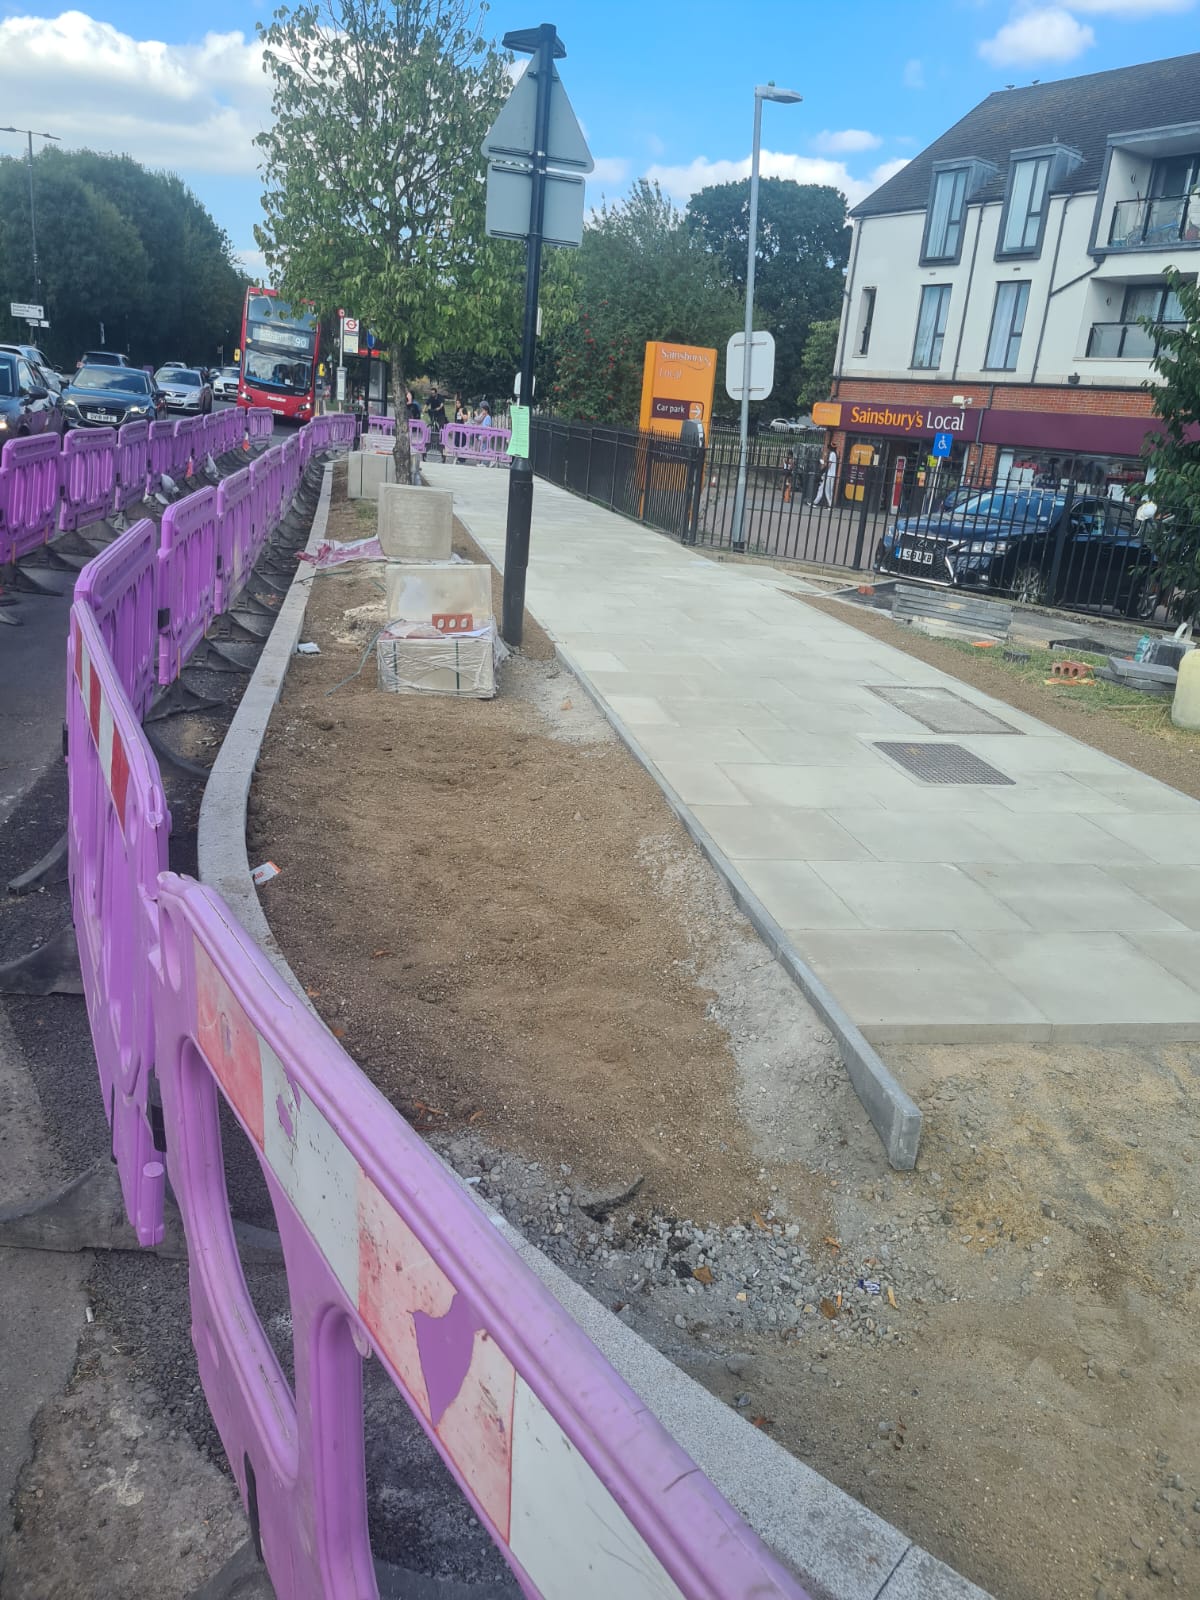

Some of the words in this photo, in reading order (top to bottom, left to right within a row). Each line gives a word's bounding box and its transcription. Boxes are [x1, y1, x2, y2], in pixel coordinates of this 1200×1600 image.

[295, 337, 306, 347] 90
[657, 403, 668, 411] Car
[669, 404, 685, 413] park
[851, 406, 923, 430] Sainsbury's
[927, 411, 965, 431] Local
